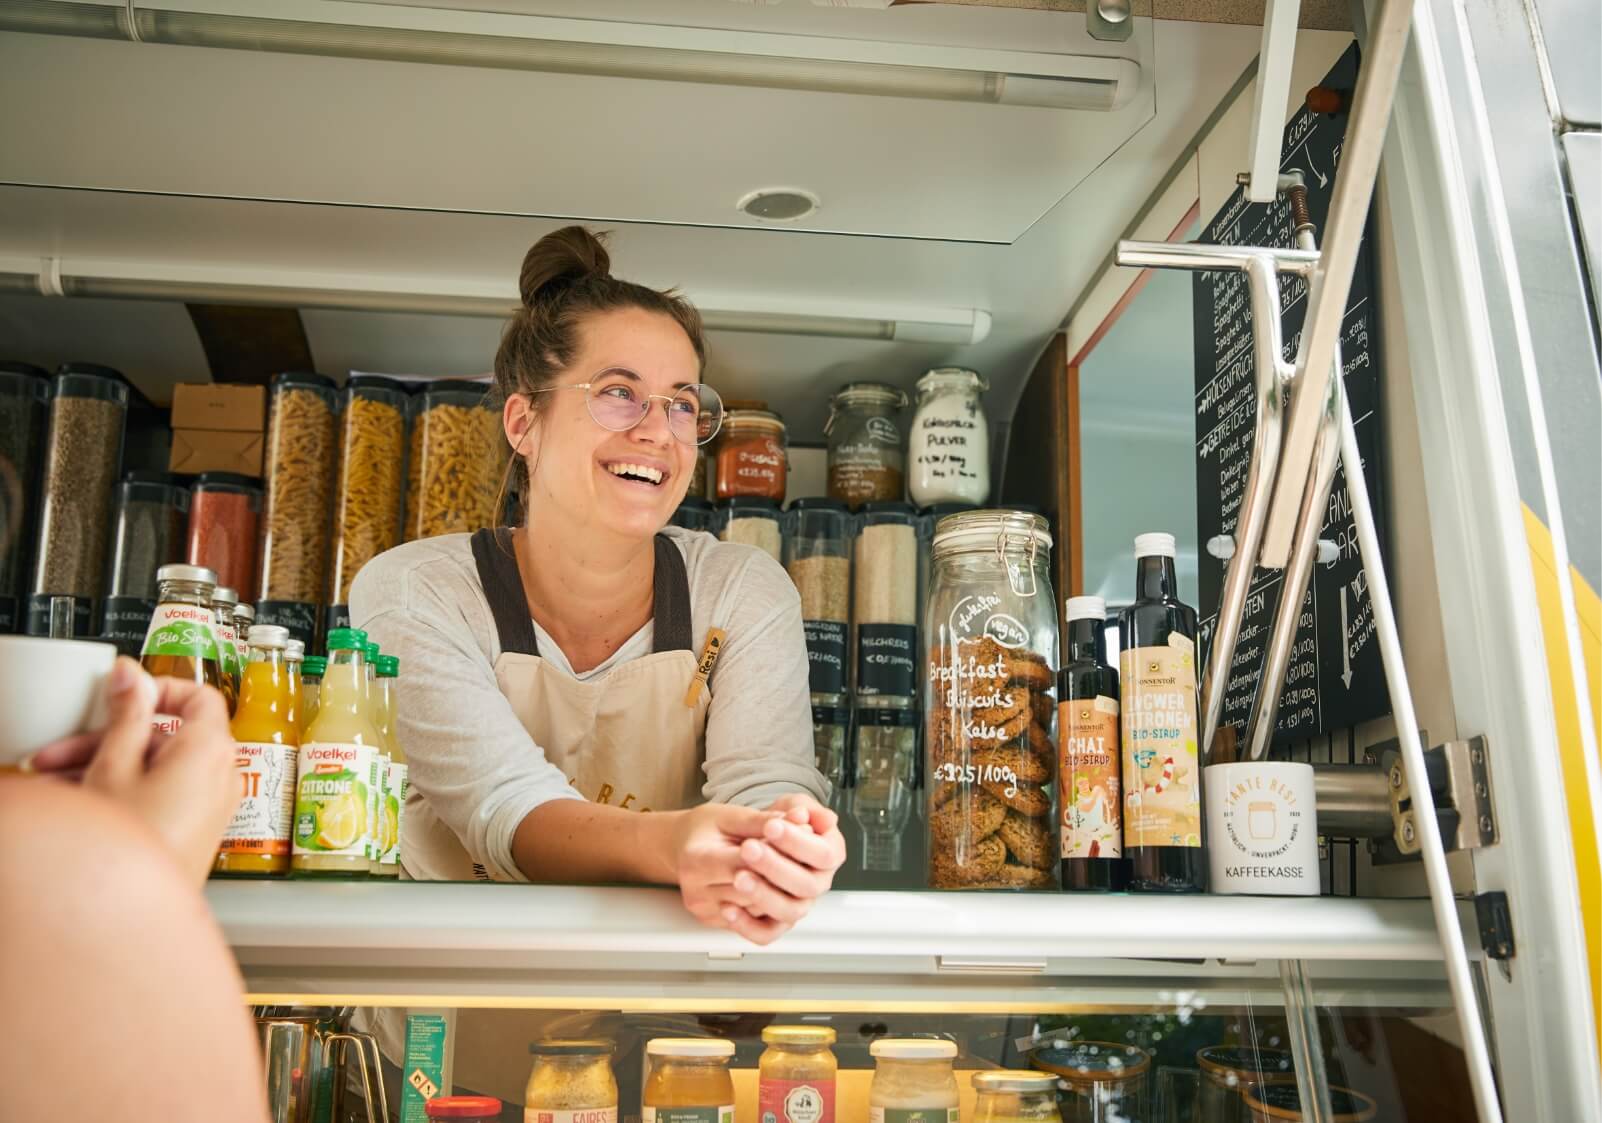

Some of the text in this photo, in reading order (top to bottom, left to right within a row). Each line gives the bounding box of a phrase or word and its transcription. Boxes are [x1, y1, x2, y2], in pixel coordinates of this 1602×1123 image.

[1208, 406, 1246, 453] GETREIDE
[991, 619, 1025, 642] vegan
[699, 650, 718, 675] Resi
[929, 655, 1008, 684] Breakfast
[1132, 728, 1181, 741] BIO-SIRUP
[1067, 736, 1105, 755] CHAI
[1064, 754, 1110, 767] BIO-SIRUP
[1225, 866, 1305, 880] KAFFEEKASSE
